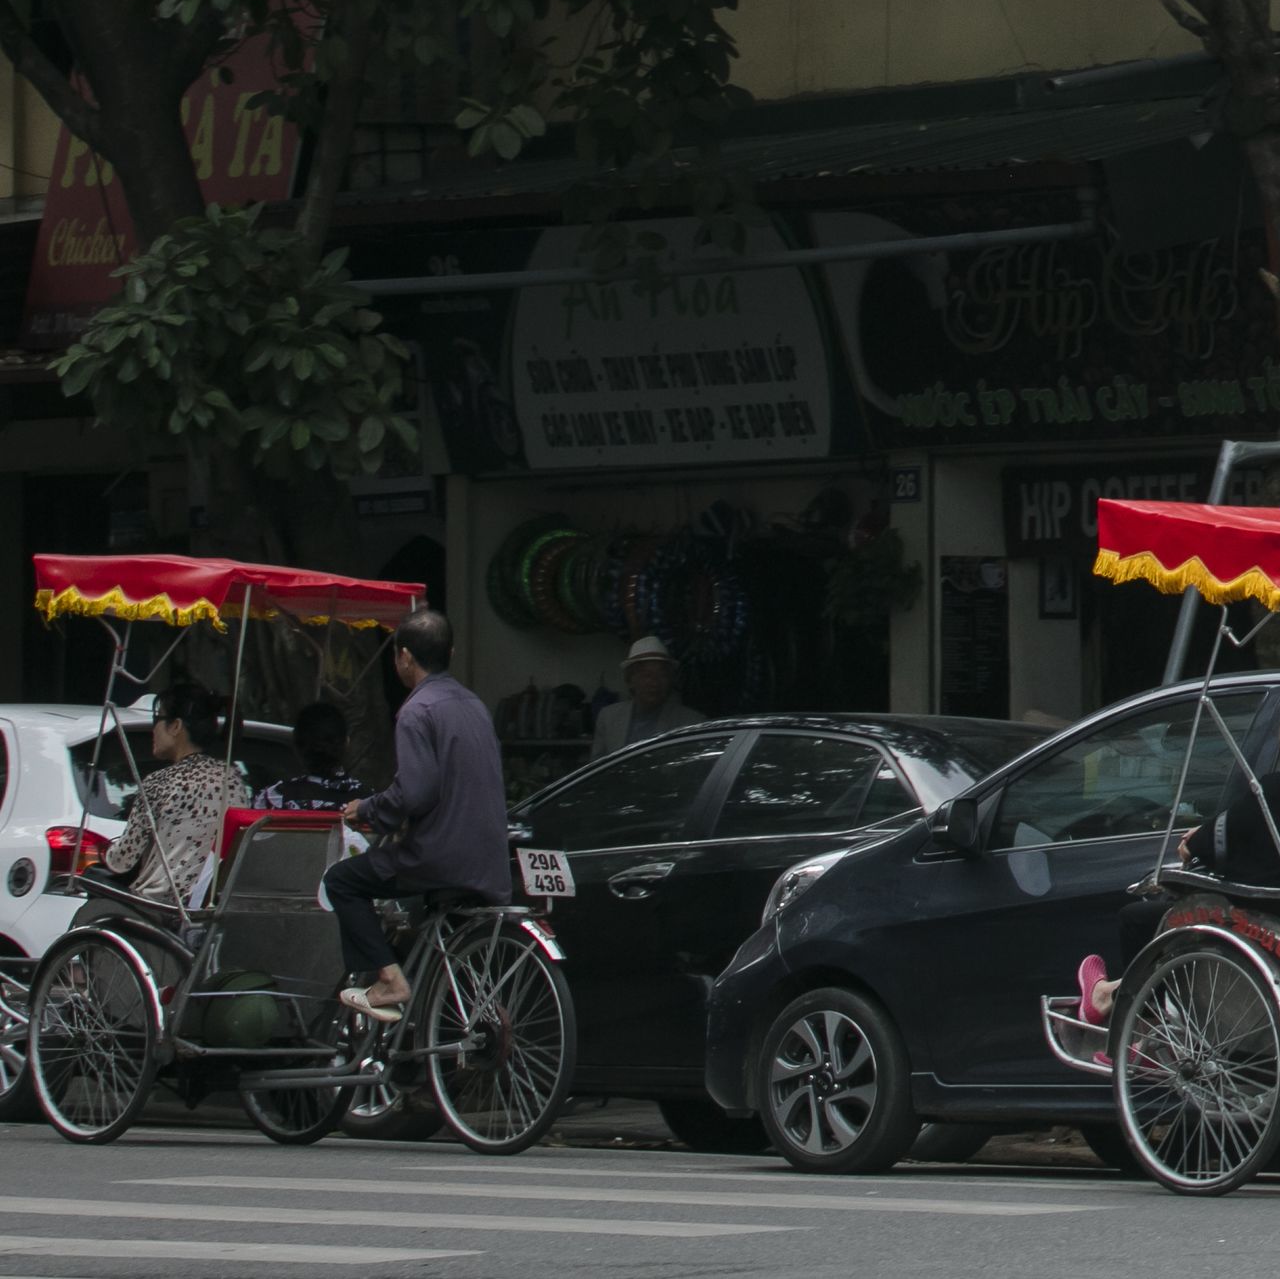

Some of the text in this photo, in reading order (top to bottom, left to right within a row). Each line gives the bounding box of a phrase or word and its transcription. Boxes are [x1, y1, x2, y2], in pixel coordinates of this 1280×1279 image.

[895, 473, 916, 498] 26
[1019, 480, 1072, 542] HIP
[528, 852, 562, 871] 29A
[535, 874, 567, 893] 436
